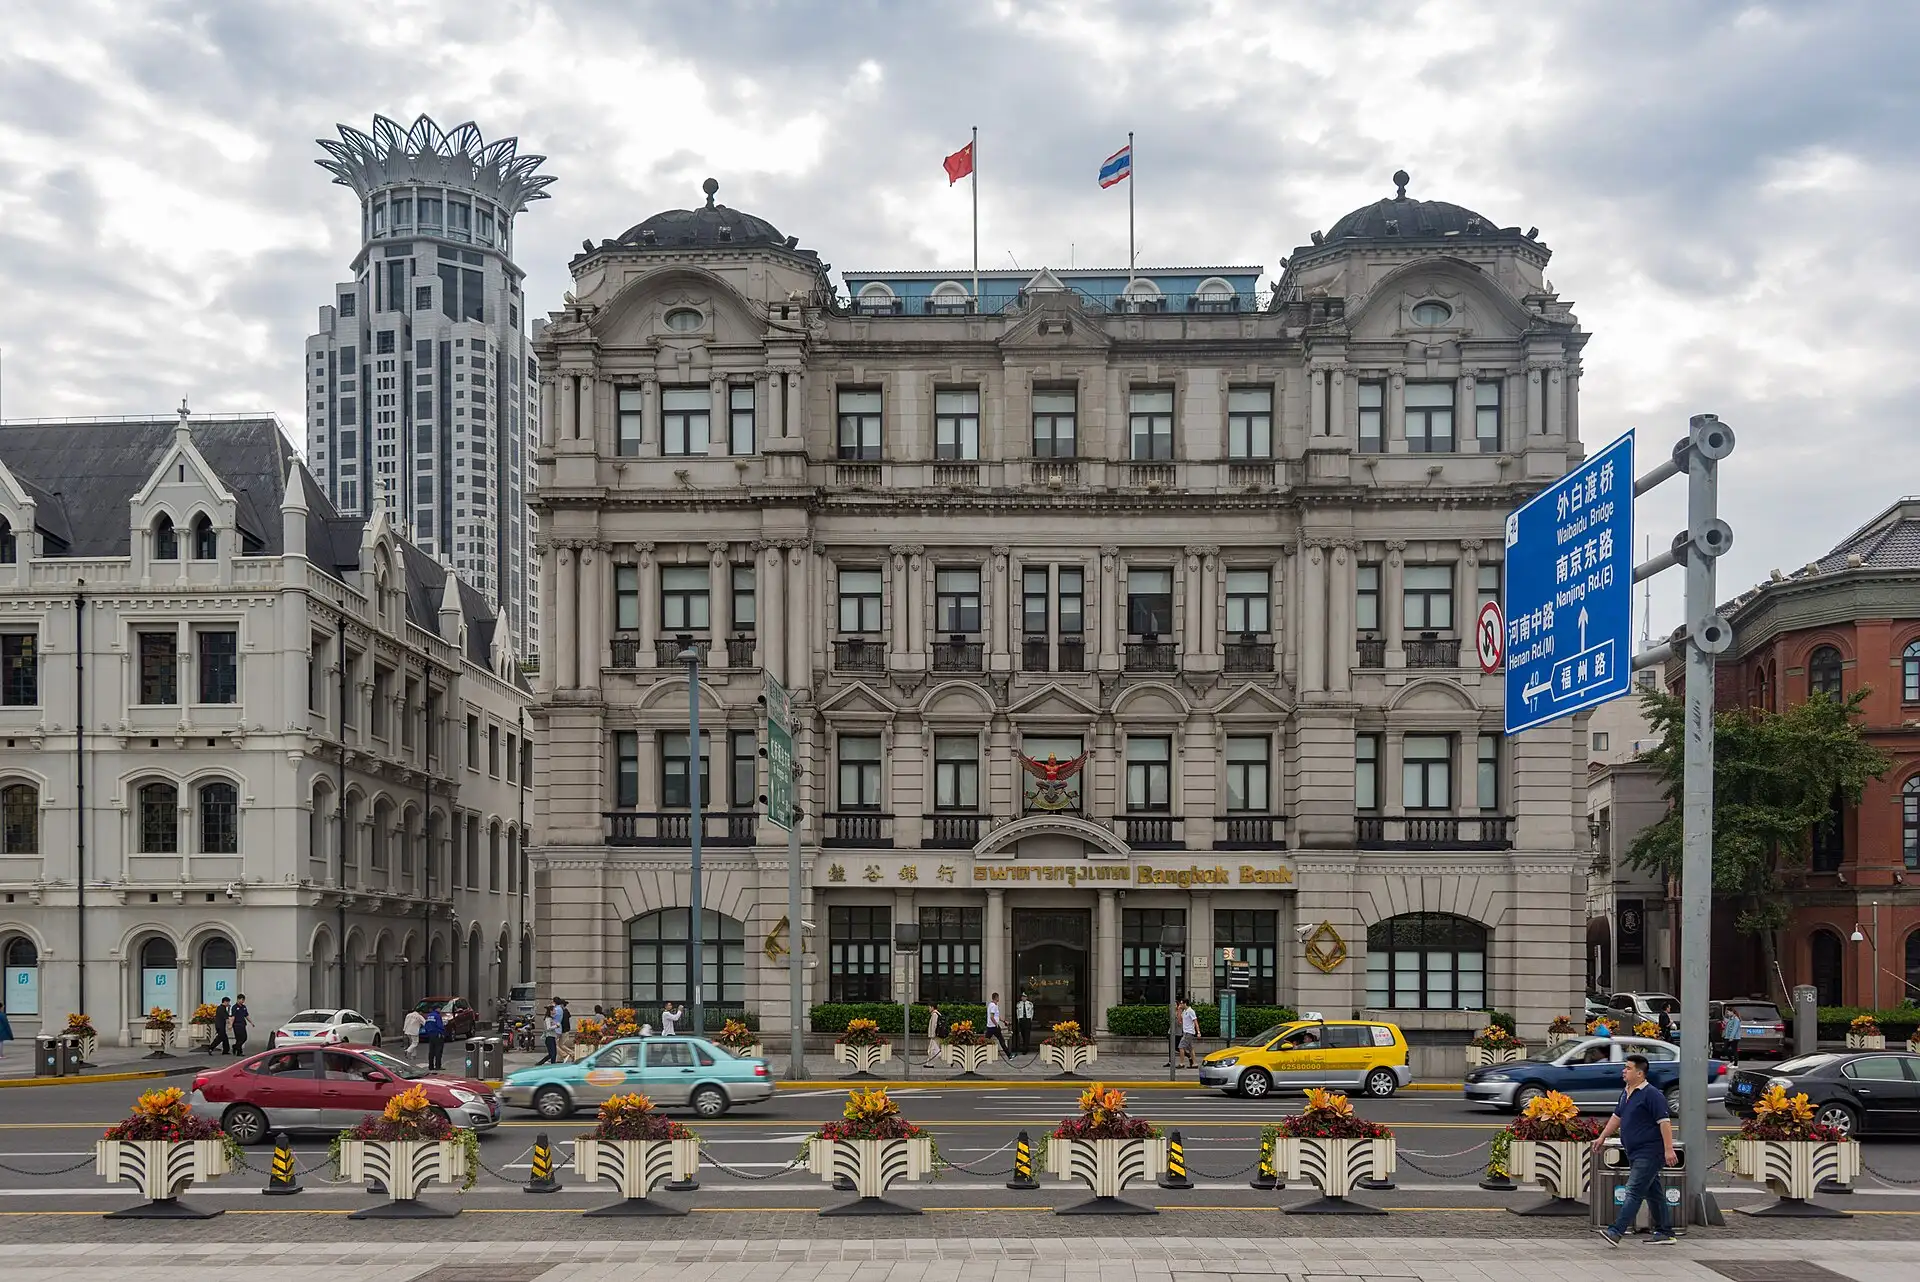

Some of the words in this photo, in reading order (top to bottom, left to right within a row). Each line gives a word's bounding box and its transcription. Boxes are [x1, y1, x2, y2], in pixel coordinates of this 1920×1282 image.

[1557, 459, 1614, 522] 外白渡桥
[1557, 515, 1587, 546] Waibaidu
[1590, 501, 1614, 526] Bridge
[1556, 528, 1613, 585] 南京东路
[1556, 582, 1585, 609] Nanjing
[1588, 563, 1613, 592] Rd.(E)
[1508, 600, 1554, 647] 河南中路
[1509, 650, 1530, 671] Henan
[1531, 634, 1555, 659] Rd.(M)
[1561, 652, 1606, 690] 福州路
[1530, 670, 1540, 687] 40
[1529, 696, 1539, 714] 17
[828, 863, 957, 883] 盤谷銀行
[974, 866, 1130, 887] ธนาคารกรุงเทพ
[1137, 865, 1229, 888] Bangkok
[1239, 865, 1293, 884] Bank
